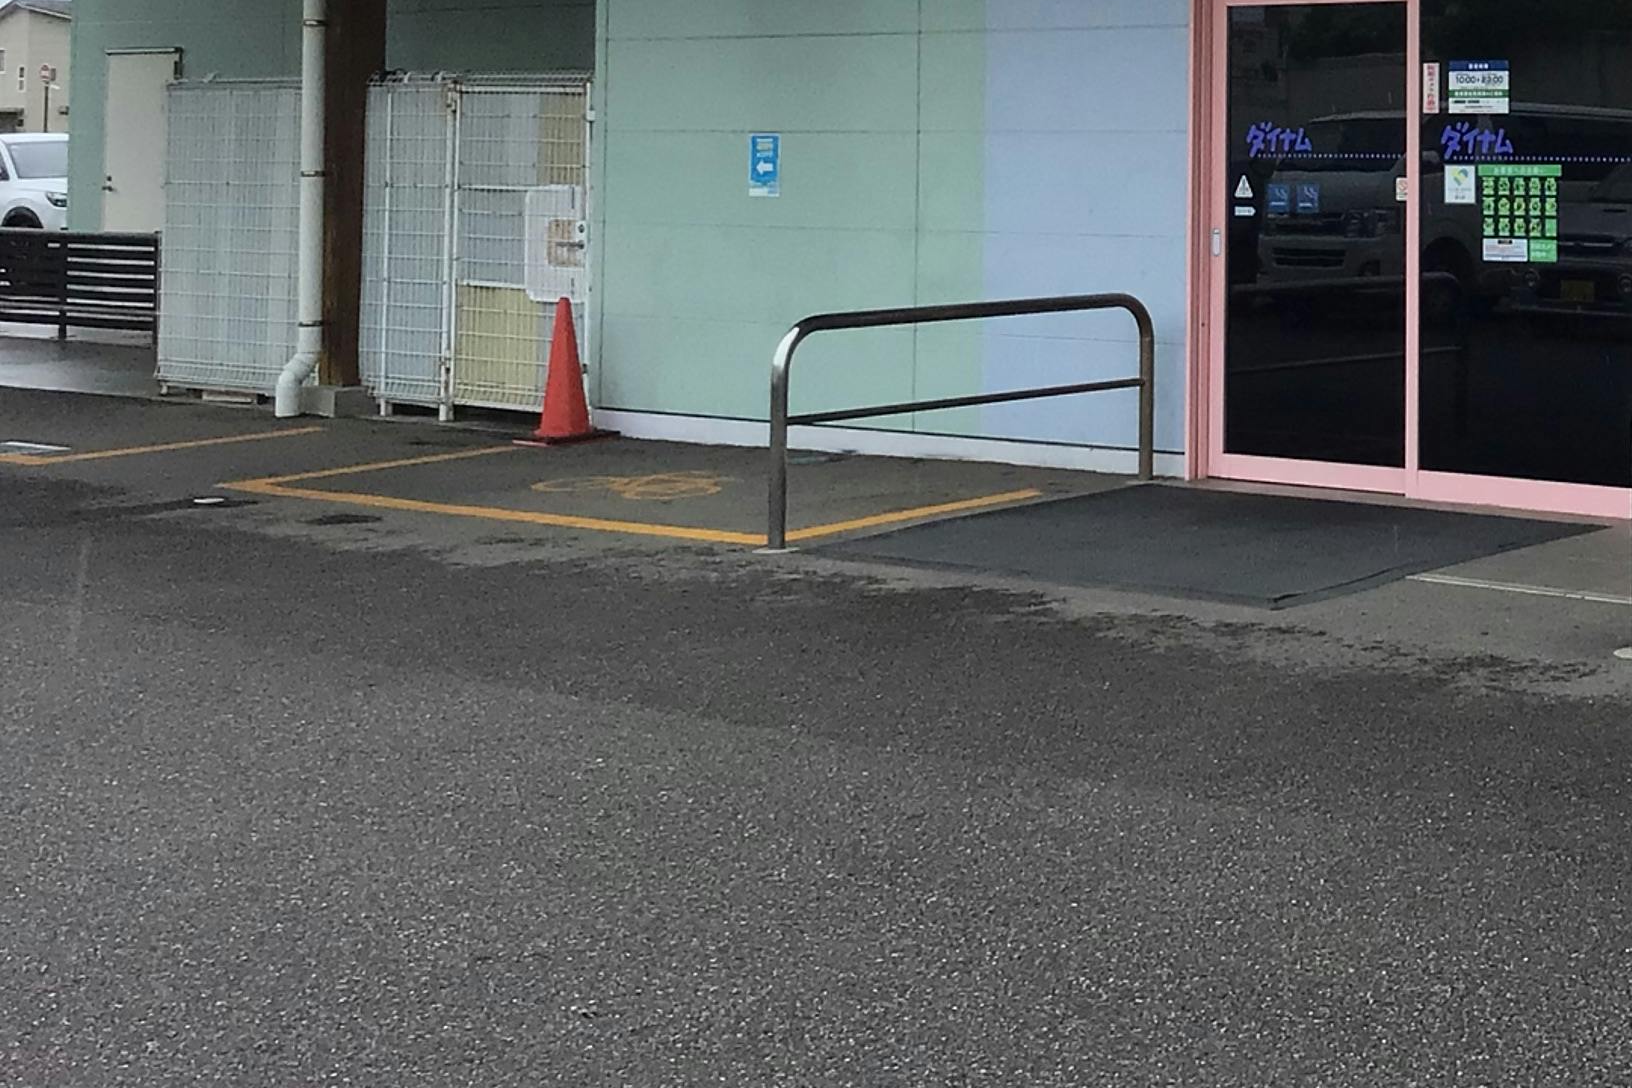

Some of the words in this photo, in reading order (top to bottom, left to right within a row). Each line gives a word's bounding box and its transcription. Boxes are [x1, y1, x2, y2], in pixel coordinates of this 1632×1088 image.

[1246, 121, 1312, 158] ダイナム
[1441, 121, 1514, 160] ダイナム
